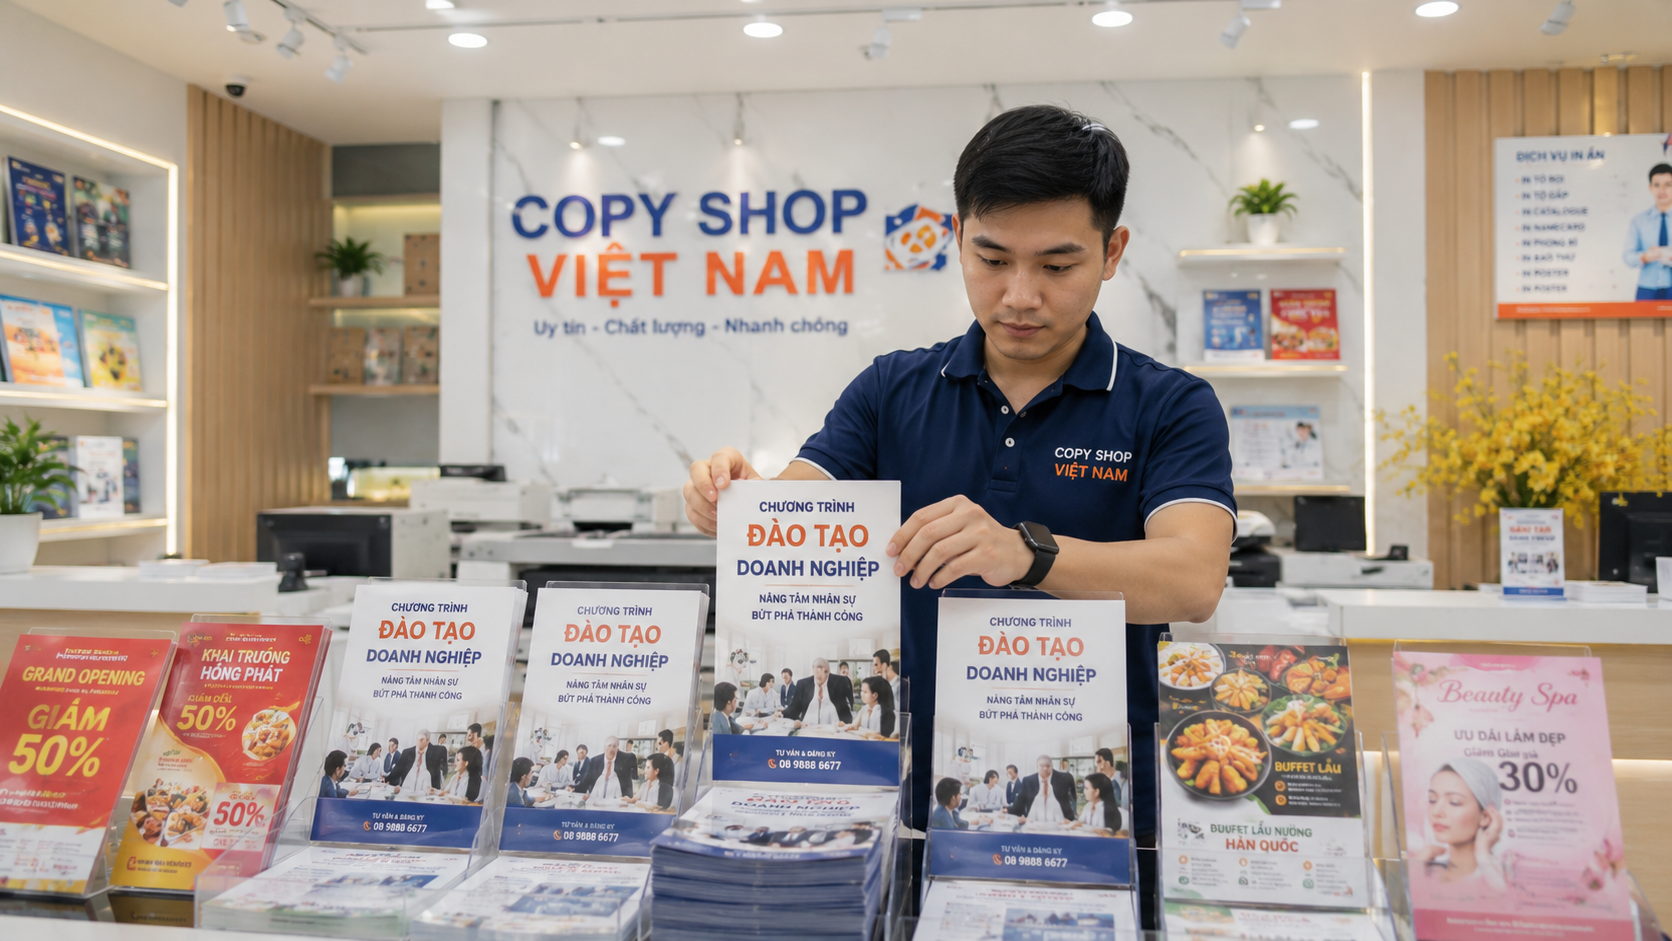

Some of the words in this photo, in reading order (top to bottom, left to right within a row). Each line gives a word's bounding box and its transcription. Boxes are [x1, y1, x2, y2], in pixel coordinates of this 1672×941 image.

[1571, 151, 1583, 161] IN
[512, 190, 677, 239] COPY
[697, 188, 867, 237] SHOP
[527, 242, 677, 308] VIỆT
[705, 249, 854, 296] NAM
[534, 321, 557, 338] Uy
[563, 320, 586, 335] tín
[605, 318, 647, 335] Chất
[652, 319, 706, 338] lượng
[725, 318, 784, 334] Nhanh
[788, 317, 848, 336] chóng
[1054, 447, 1092, 460] COPY
[1095, 449, 1132, 463] SHOP
[1055, 461, 1089, 480] VIỆT
[1092, 466, 1128, 482] NAM
[759, 500, 814, 512] CHƯƠNG
[817, 498, 855, 513] TRÌNH
[746, 518, 806, 547] ĐÀO
[814, 523, 869, 553] TẠO
[737, 559, 804, 577] DOANH
[810, 556, 880, 581] NGHIỆP
[391, 602, 435, 613] CHƯƠNG
[437, 602, 468, 614] TRÌNH
[577, 605, 620, 615] CHƯƠNG
[622, 604, 653, 616] TRÌNH
[378, 616, 426, 640] ĐÀO
[432, 621, 476, 645] TẠO
[989, 616, 1036, 627] CHƯƠNG
[1039, 615, 1072, 628] TRÌNH
[564, 619, 612, 643] ĐÀO
[617, 624, 662, 649] TẠO
[201, 648, 235, 663] KHAI
[977, 630, 1030, 656] ĐÀO
[1036, 636, 1085, 661] TẠO
[366, 648, 421, 664] DOANH
[425, 648, 482, 668] NGHIỆP
[550, 652, 607, 667] DOANH
[610, 651, 669, 672] NGHIỆP
[22, 665, 76, 683] GRAND
[78, 668, 146, 686] OPENING
[243, 664, 283, 683] PHÁT
[966, 666, 1028, 681] DOANH
[1032, 664, 1097, 686] NGHIỆP
[1437, 679, 1524, 712] Beauty
[1531, 682, 1578, 712] Spa
[176, 704, 237, 731] 50%
[8, 733, 104, 778] 50%
[779, 759, 791, 769] 08
[793, 760, 816, 770] 9888
[818, 761, 841, 770] 6677
[1274, 761, 1316, 773] BUFFET
[1498, 761, 1578, 794] 30%
[213, 800, 265, 828] 50%
[373, 822, 384, 831] 08
[407, 823, 428, 833] 6677
[563, 831, 574, 840] 08
[598, 832, 619, 842] 6677
[1004, 855, 1016, 865] 08
[1018, 856, 1042, 866] 9888
[1044, 857, 1068, 868] 6677
